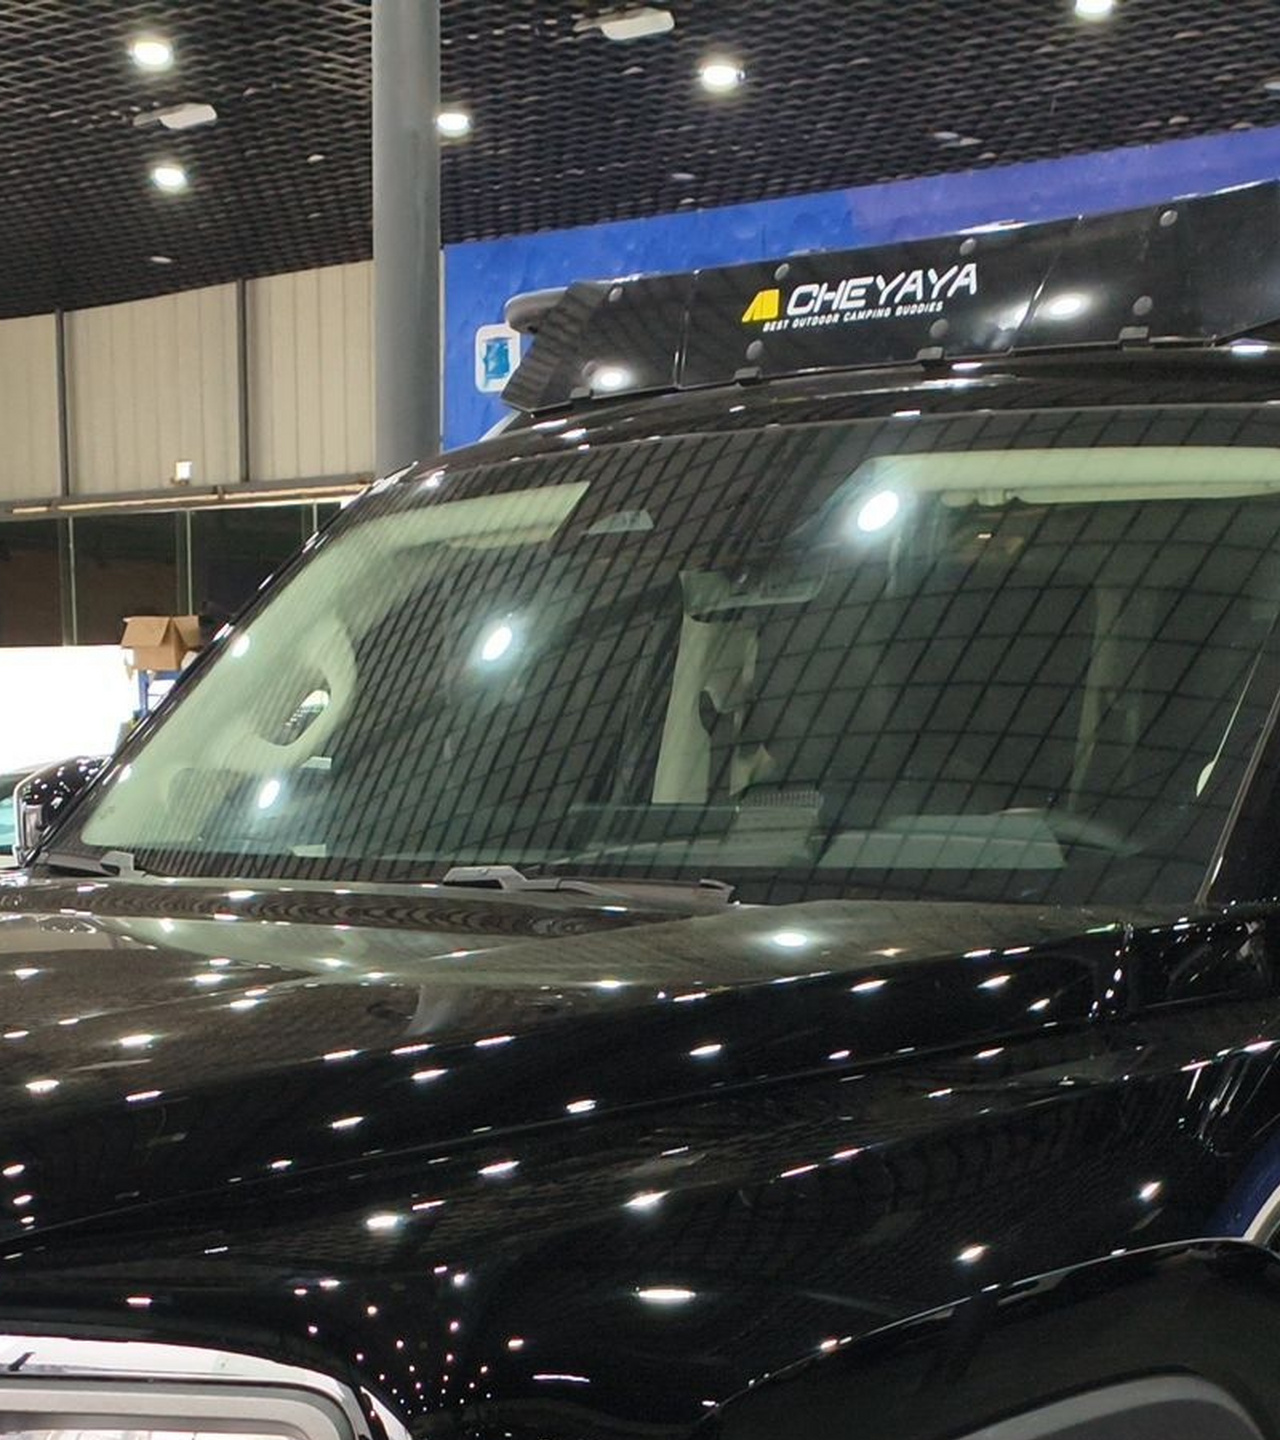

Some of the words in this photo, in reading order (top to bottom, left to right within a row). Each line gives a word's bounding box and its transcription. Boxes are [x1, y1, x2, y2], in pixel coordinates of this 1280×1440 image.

[786, 263, 977, 316] CHEYAYA
[762, 322, 789, 333] BEST
[791, 315, 839, 329] OUTDOOR
[843, 307, 892, 322] CAMPING
[895, 300, 943, 315] BUDDIES
